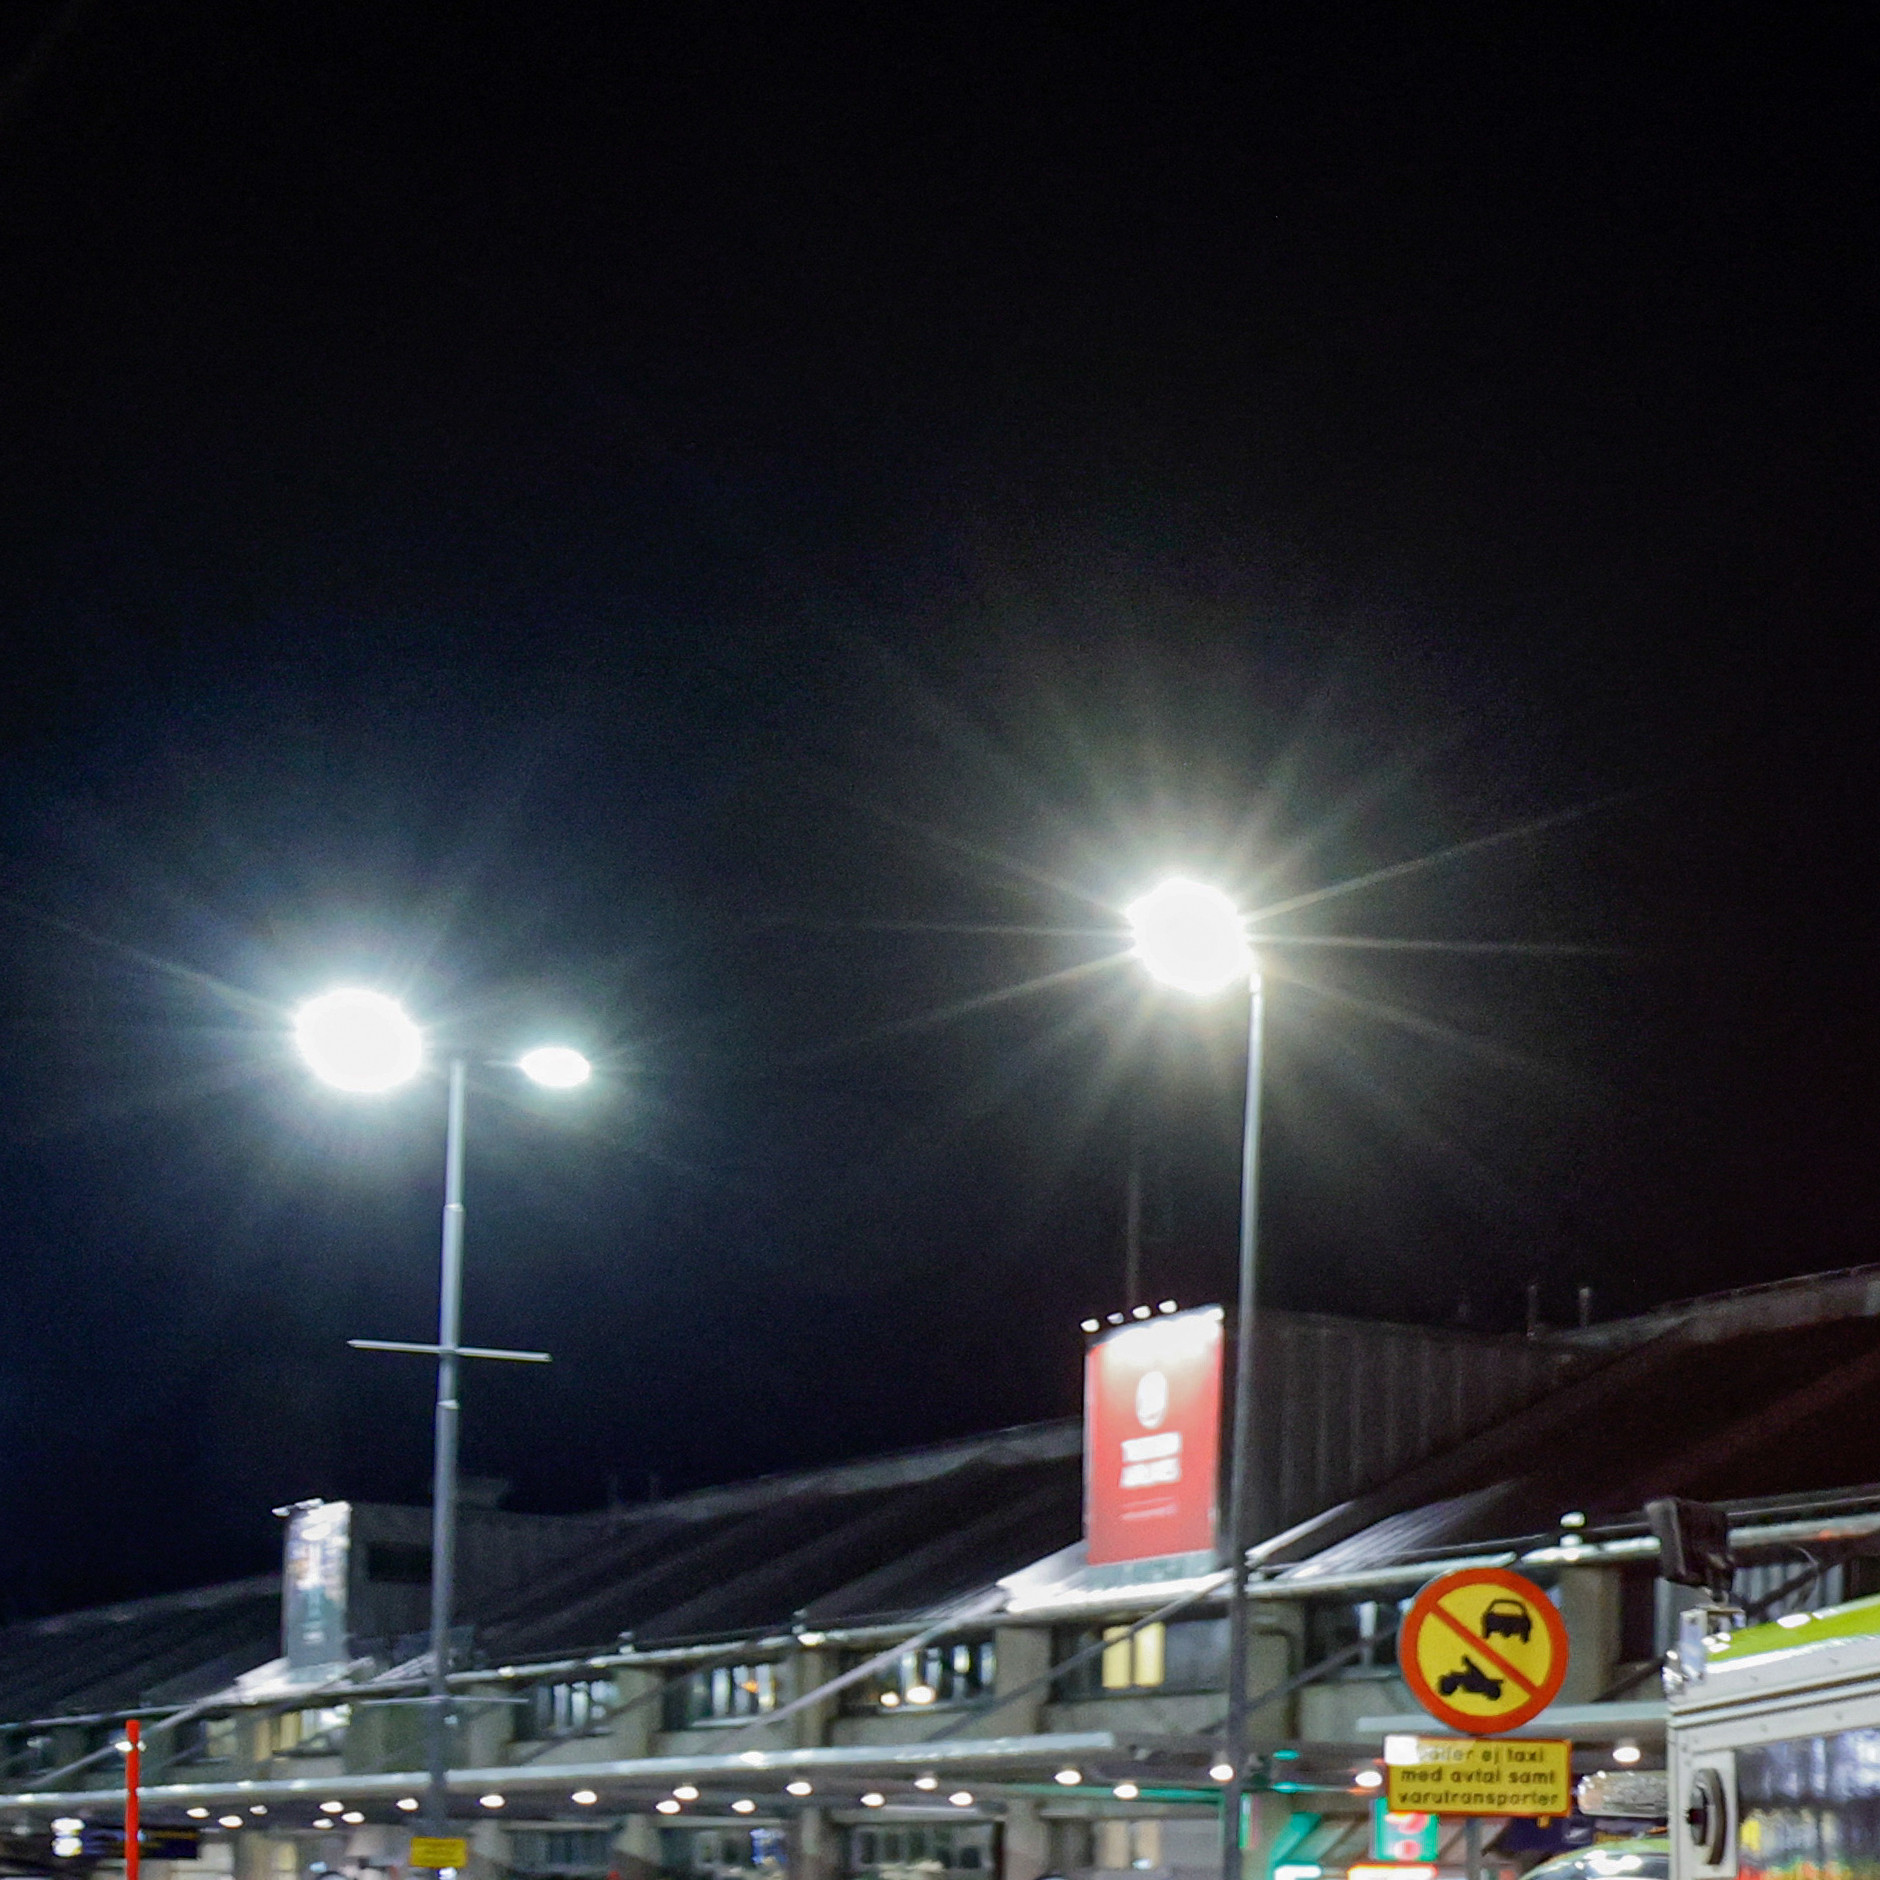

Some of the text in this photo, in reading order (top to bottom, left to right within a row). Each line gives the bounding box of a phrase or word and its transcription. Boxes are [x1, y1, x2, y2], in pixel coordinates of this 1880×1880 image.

[1507, 1747, 1544, 1763] taxi
[1401, 1765, 1556, 1785] med avtal samt
[1399, 1789, 1559, 1808] varutransporter
